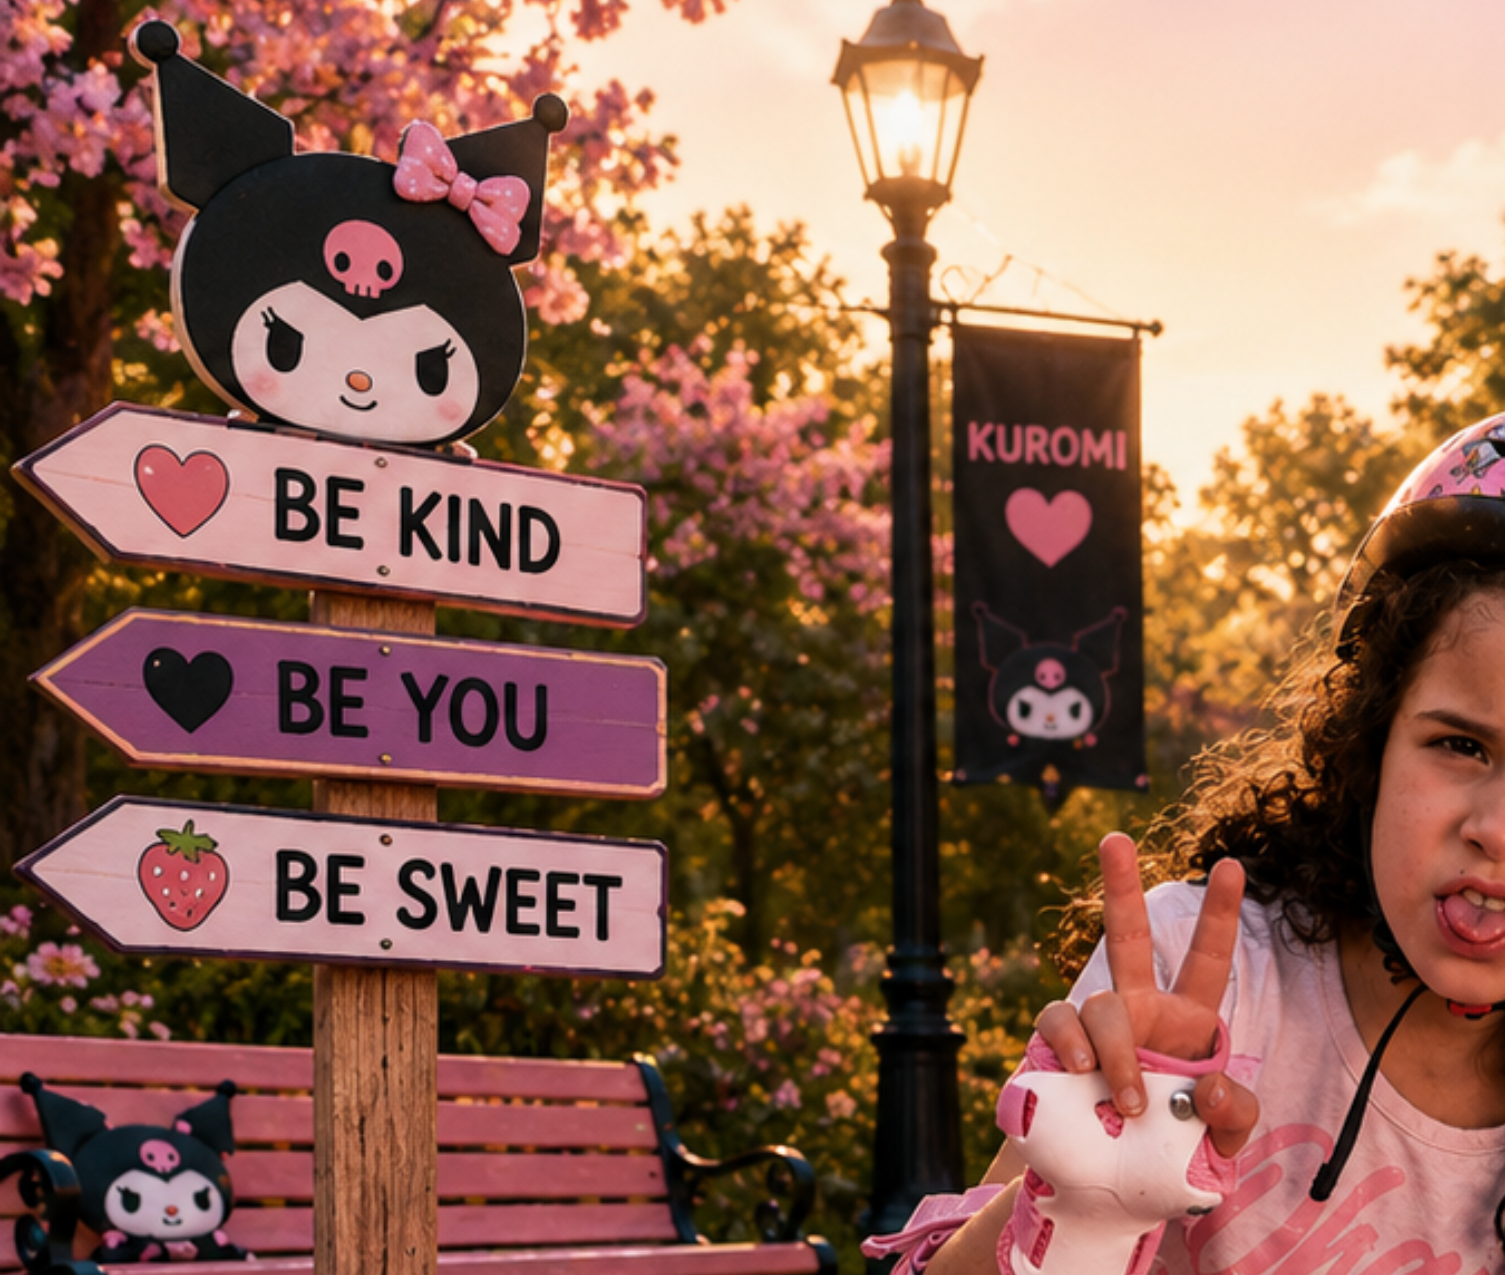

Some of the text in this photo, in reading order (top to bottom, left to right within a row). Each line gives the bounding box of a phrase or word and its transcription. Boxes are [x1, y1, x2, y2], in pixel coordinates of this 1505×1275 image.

[967, 421, 1128, 472] KUROMI
[274, 467, 561, 574] BE KIND
[276, 659, 549, 752] BE YOU
[275, 848, 623, 941] BE SWEET
